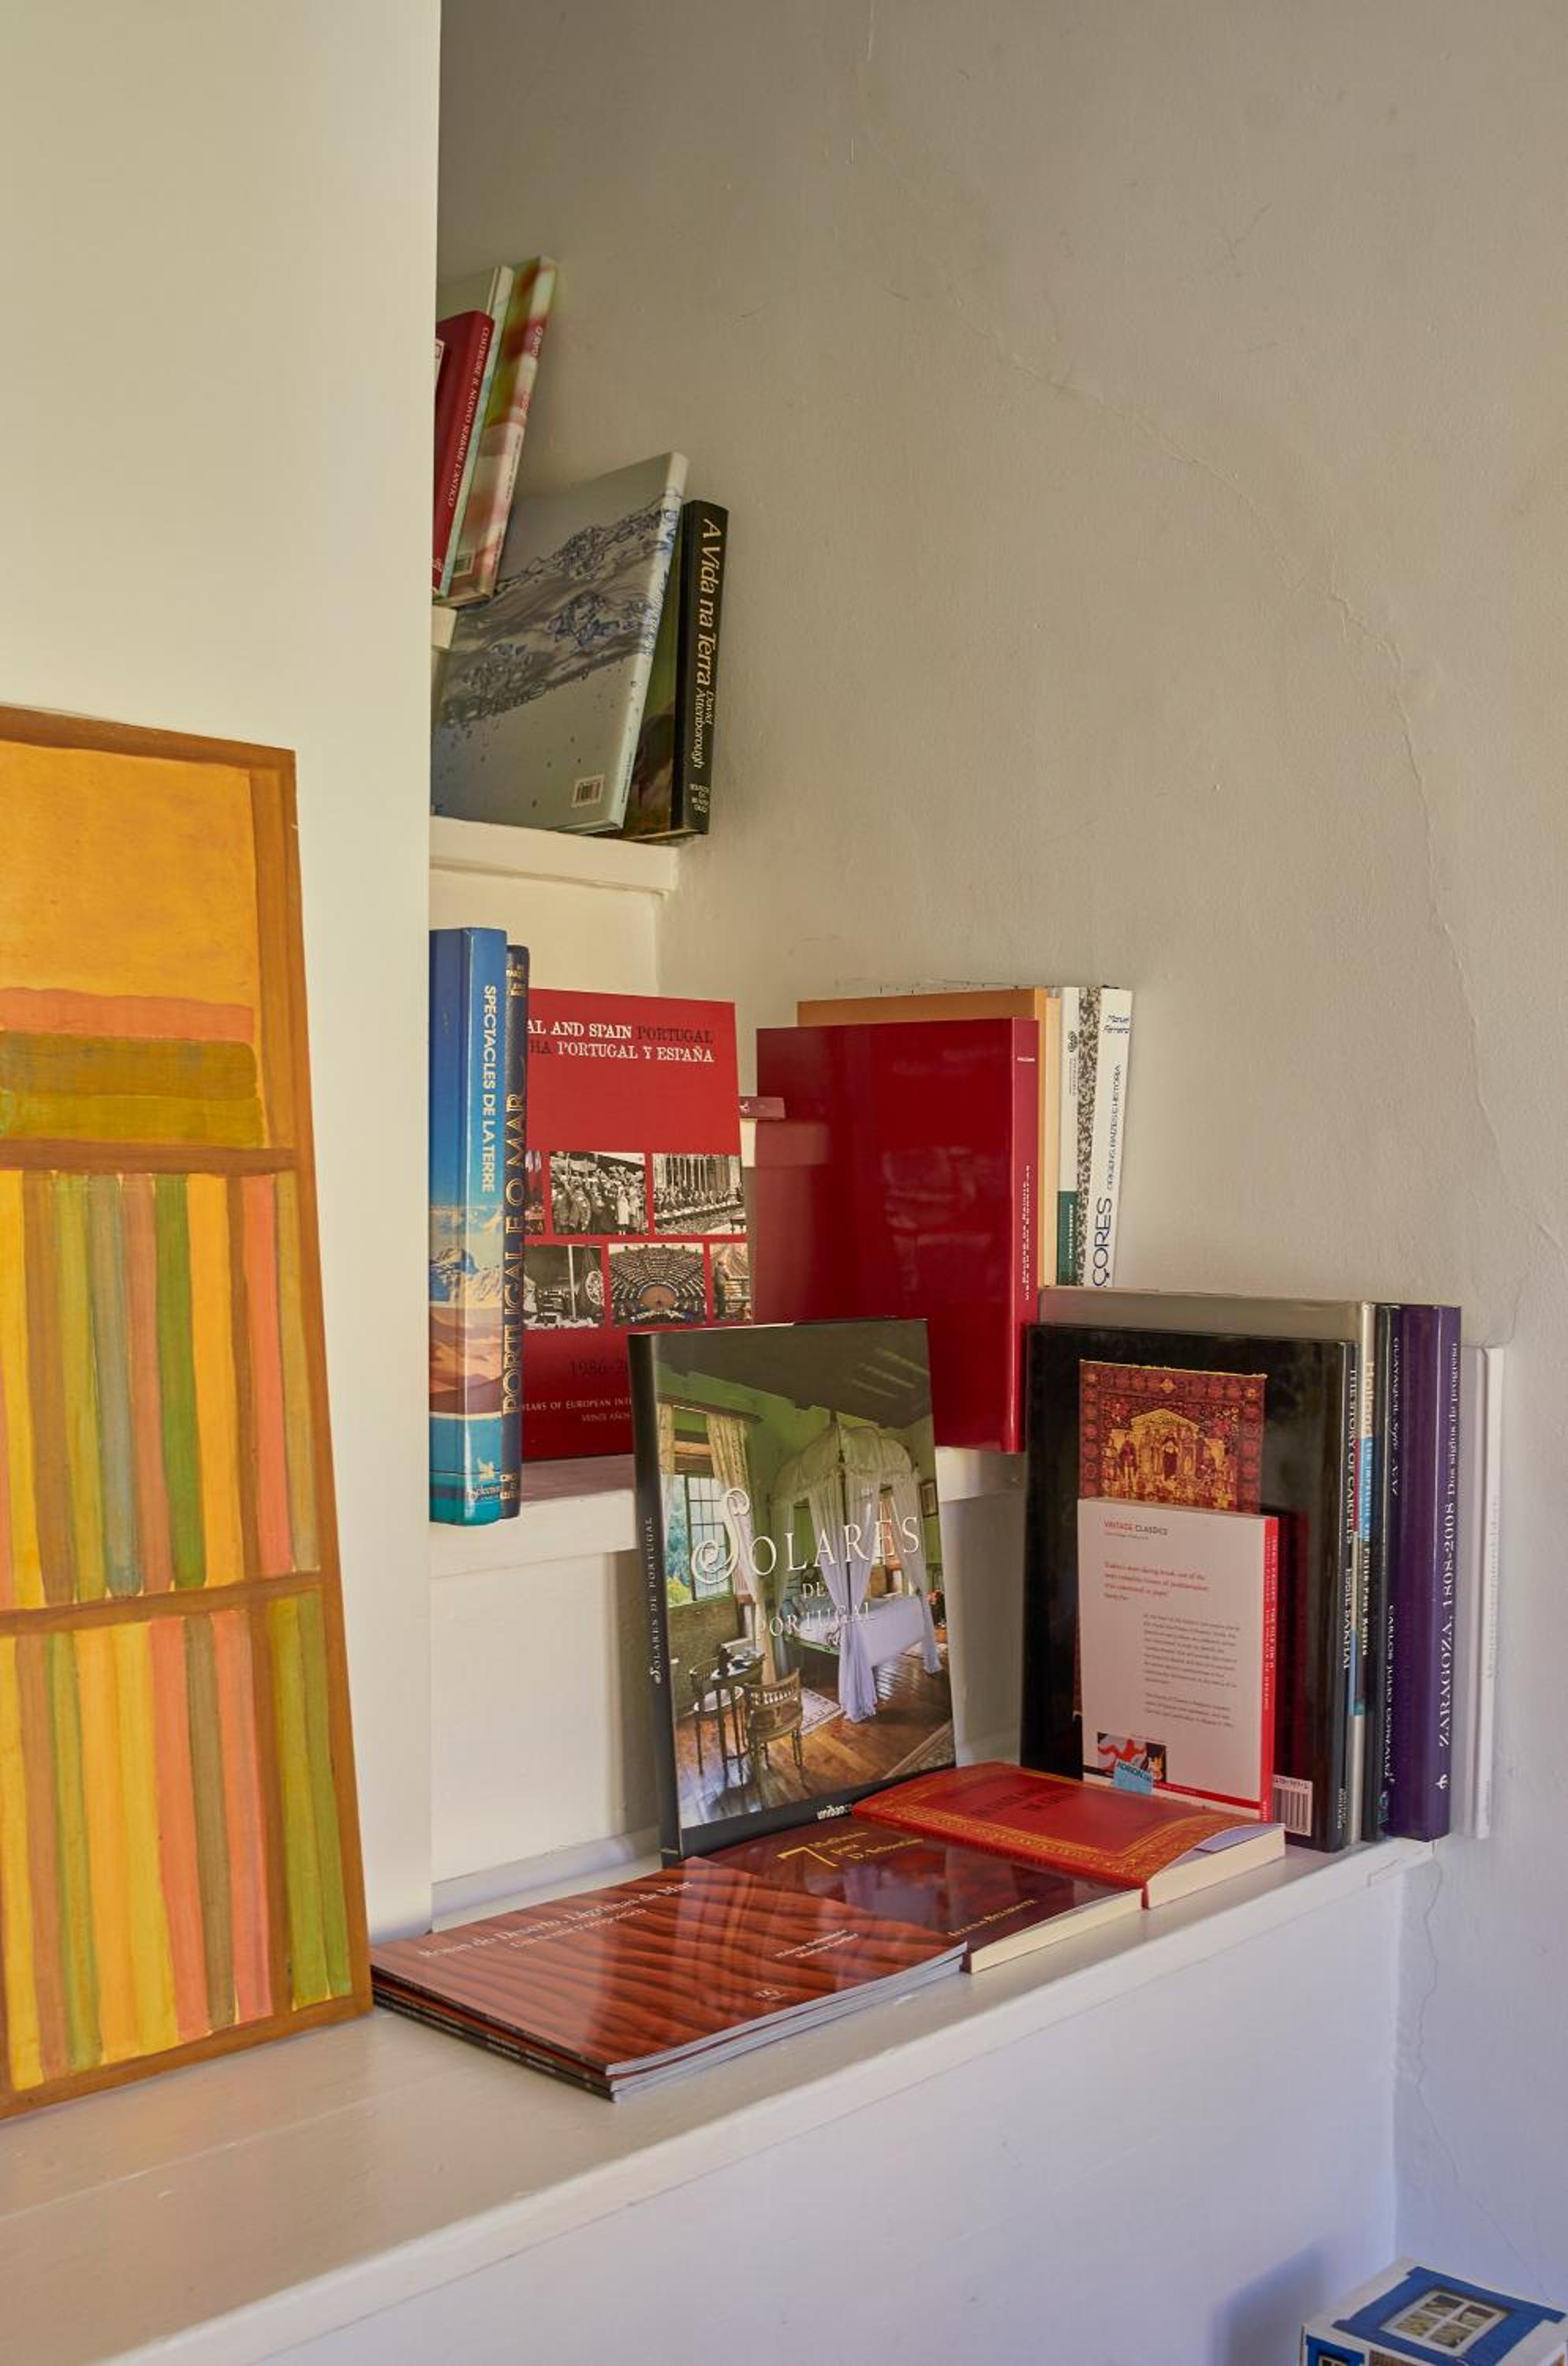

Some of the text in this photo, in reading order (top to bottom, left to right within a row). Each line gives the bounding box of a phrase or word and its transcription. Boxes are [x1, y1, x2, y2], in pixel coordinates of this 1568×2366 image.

[695, 518, 722, 689] A Vida na Terra
[690, 687, 708, 770] Attenborough
[551, 1022, 584, 1037] AND
[588, 1023, 632, 1039] SPAIN
[637, 1027, 714, 1044] PORTUGAL
[556, 1041, 638, 1059] PORTUGAL
[643, 1046, 652, 1059] Y
[657, 1045, 715, 1063] ESPAÑA
[481, 986, 497, 1193] SPECTACLES DE LA TERRE
[506, 1181, 525, 1206] O
[1092, 1196, 1113, 1288] ÇORES
[566, 1398, 611, 1410] EUROPEAN
[690, 1487, 921, 1586] SOLARES
[1443, 1502, 1455, 1607] 1808-2008
[801, 1580, 827, 1599] DE
[755, 1600, 876, 1640] PORTUGAL
[777, 1845, 838, 1868] 7
